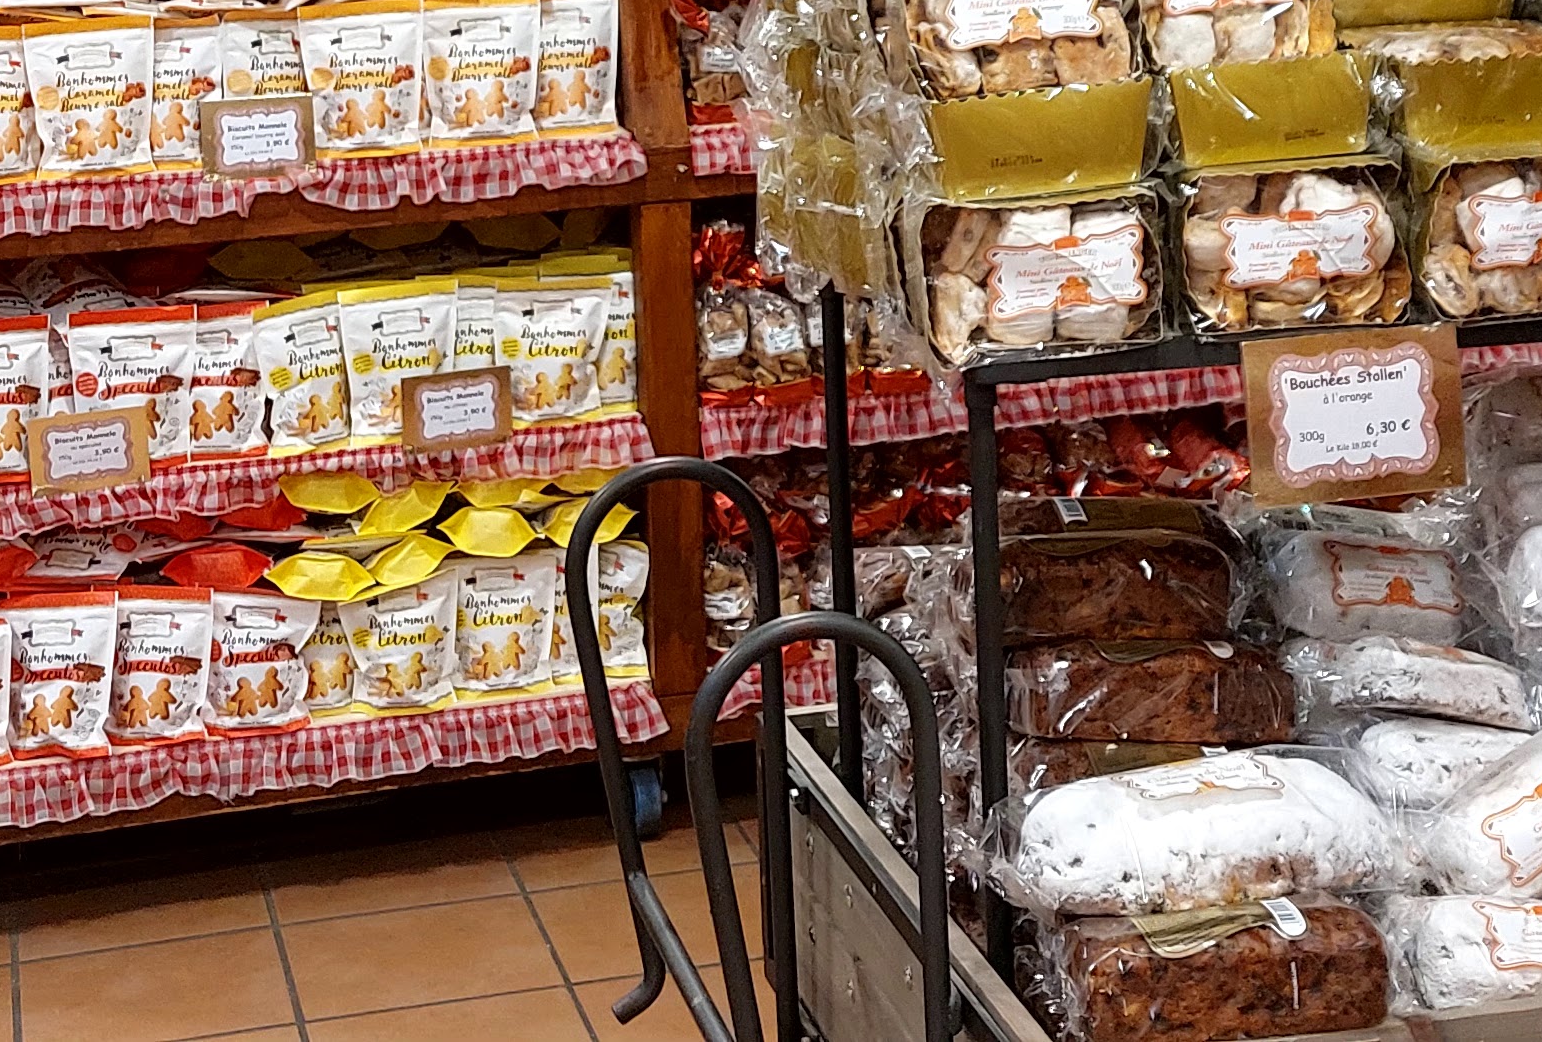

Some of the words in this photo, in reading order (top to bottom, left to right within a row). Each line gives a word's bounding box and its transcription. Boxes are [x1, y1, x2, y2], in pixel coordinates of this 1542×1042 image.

[969, 0, 993, 10] Mini
[540, 35, 597, 49] onhommes
[56, 72, 129, 88] Bonhommes
[1249, 241, 1273, 250] Mini
[1016, 267, 1041, 278] Mini
[455, 338, 493, 356] Citro
[529, 339, 578, 357] Citron
[382, 353, 431, 370] Citron
[1323, 394, 1329, 404] à
[1331, 391, 1373, 404] l'orange
[1299, 430, 1325, 443] 300g
[1366, 421, 1397, 437] 6,30
[1401, 419, 1411, 431] €
[473, 609, 524, 627] Citron
[378, 631, 426, 647] Citron
